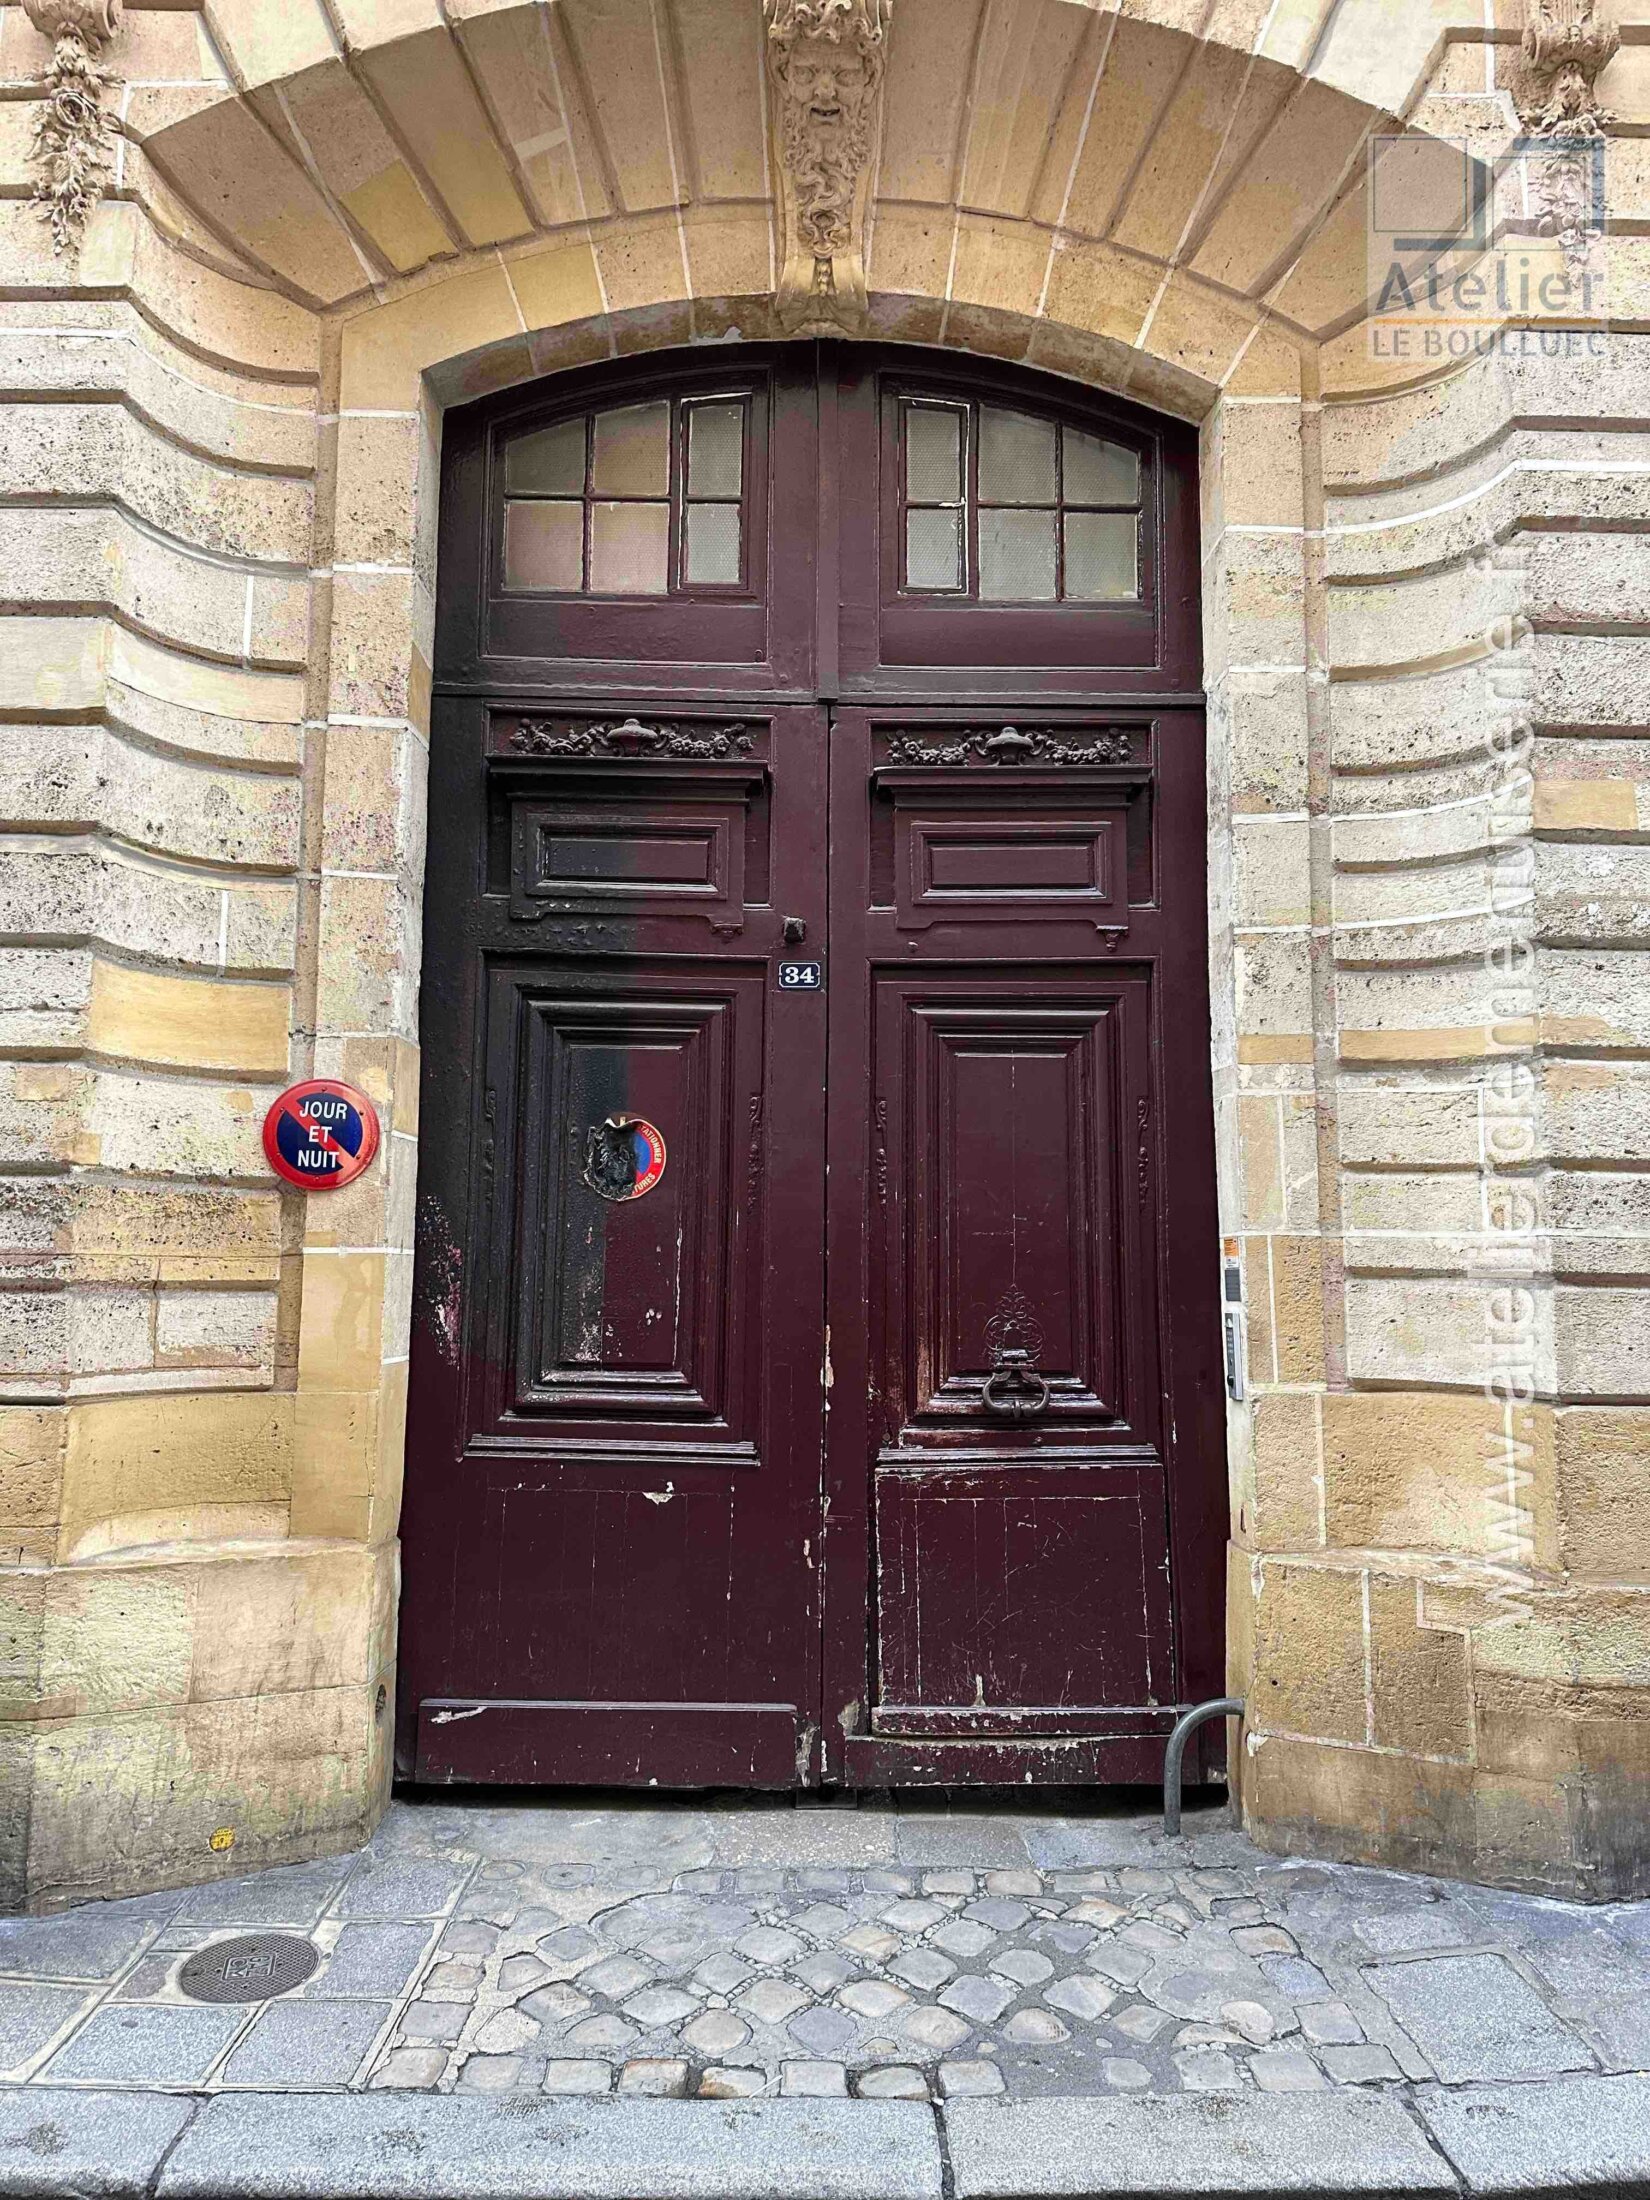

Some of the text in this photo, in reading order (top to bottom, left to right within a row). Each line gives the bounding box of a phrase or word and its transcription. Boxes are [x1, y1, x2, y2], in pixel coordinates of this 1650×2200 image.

[784, 966, 815, 984] 34
[299, 1101, 348, 1120] JOUR
[308, 1125, 333, 1143] ET
[640, 1125, 662, 1163] TATIONNER
[297, 1149, 340, 1169] NUIT
